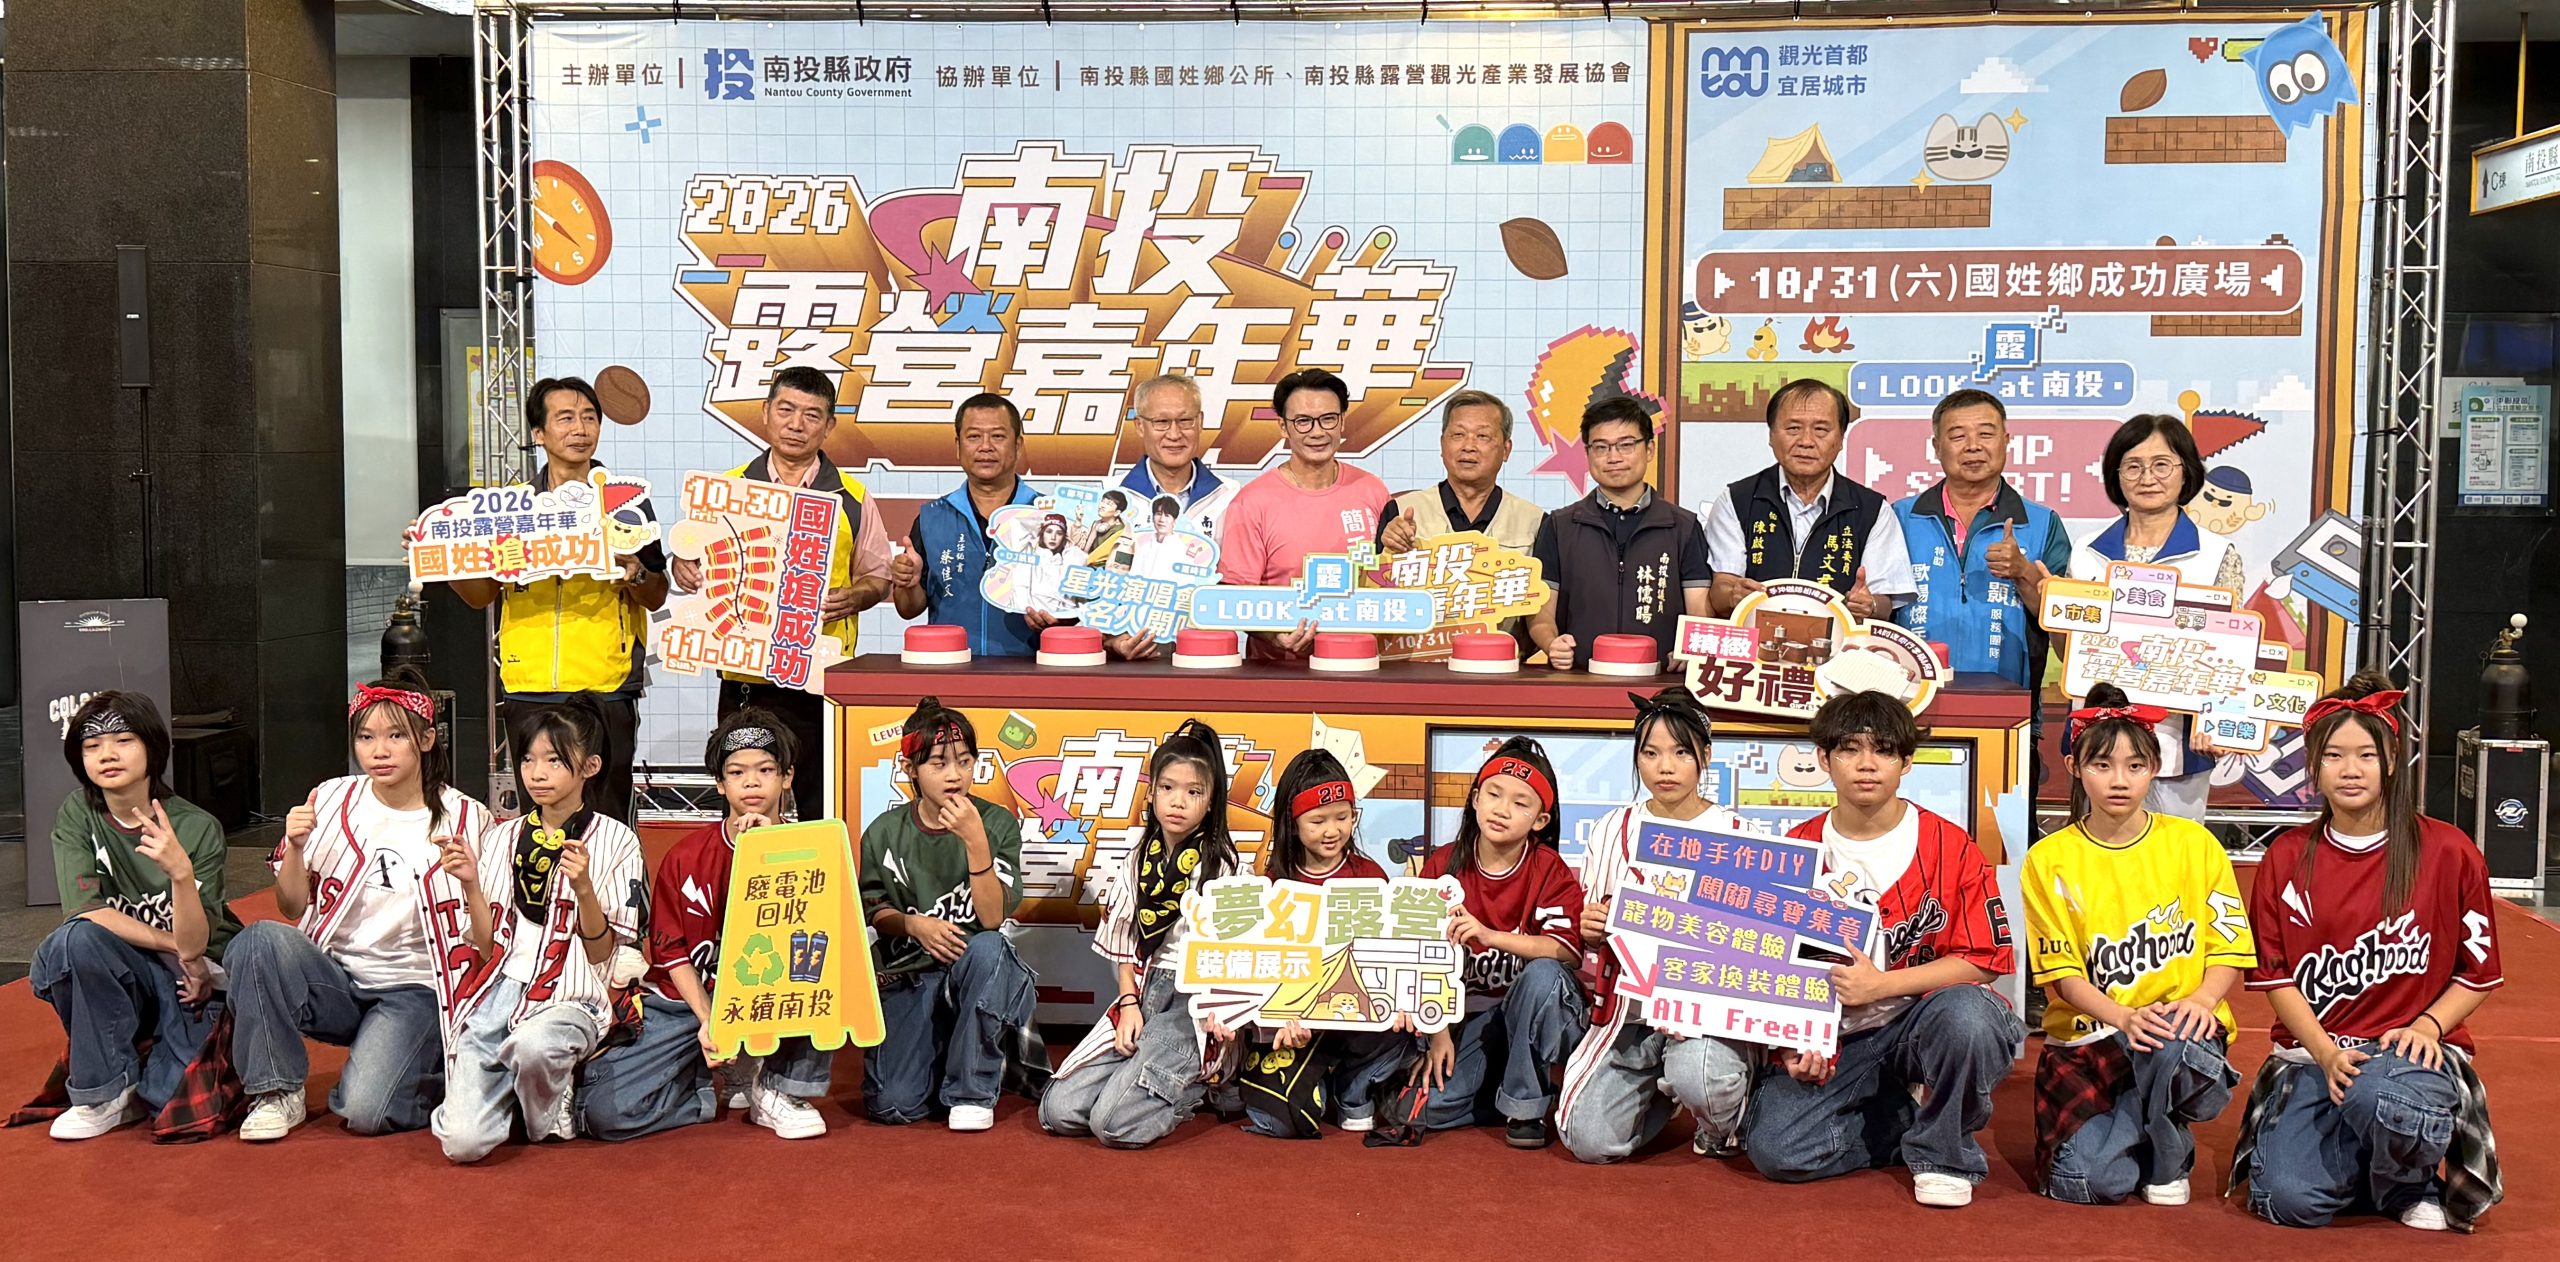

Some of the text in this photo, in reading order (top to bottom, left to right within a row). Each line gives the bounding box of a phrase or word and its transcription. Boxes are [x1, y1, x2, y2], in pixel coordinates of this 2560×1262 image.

[763, 55, 913, 84] 南投縣政府
[1778, 44, 1869, 67] 觀光首都
[562, 64, 664, 88] 主辦單位
[936, 65, 1041, 89] 協辦單位
[1080, 62, 1632, 88] 南投縣國姓鄉公所、南投縣露營觀光產業發展協會
[1777, 74, 1868, 97] 宜居城市
[765, 87, 912, 102] Nantou County Government
[946, 146, 1270, 296] 南投
[710, 265, 1453, 438] 露營嘉年華
[1995, 330, 2026, 361] 露
[1879, 374, 1967, 398] LOOK
[1926, 435, 2053, 465] CMP
[685, 475, 793, 523] 10.30
[1907, 472, 2071, 502] SRT!
[472, 490, 533, 515] 2026
[689, 507, 718, 524] Fri.
[431, 510, 578, 540] 南投露營嘉年華
[413, 532, 600, 578] 國姓搶成功
[1390, 541, 1478, 588] 南投
[1841, 525, 1853, 576] 立法委員
[769, 496, 834, 685] 國姓搶成功
[1316, 563, 1343, 589] 露
[1217, 599, 1294, 620] LOOK
[2127, 587, 2167, 608] 美食
[2064, 604, 2102, 625] 市集
[662, 625, 766, 672] 11.01
[1688, 631, 1753, 659] 精緻
[2137, 634, 2210, 669] 南投
[667, 658, 697, 673] Sun.
[1695, 655, 1817, 708] 好禮
[2266, 695, 2307, 715] 文化
[873, 724, 904, 742] LEVE
[2217, 719, 2257, 740] 音樂
[1499, 760, 1533, 781] 23
[1318, 784, 1346, 804] 23
[1650, 832, 1806, 877] 在地手作DIY
[744, 868, 826, 902] 廢電池
[756, 898, 809, 928] 回收
[1211, 883, 1448, 945] 夢幻露營
[1621, 898, 1788, 961] 寵物美容體驗
[1196, 948, 1312, 980] 裝備展示
[1662, 956, 1831, 1004] 客家換裝體驗
[721, 988, 834, 1025] 永續南投
[1652, 998, 1832, 1047] All Free!!
